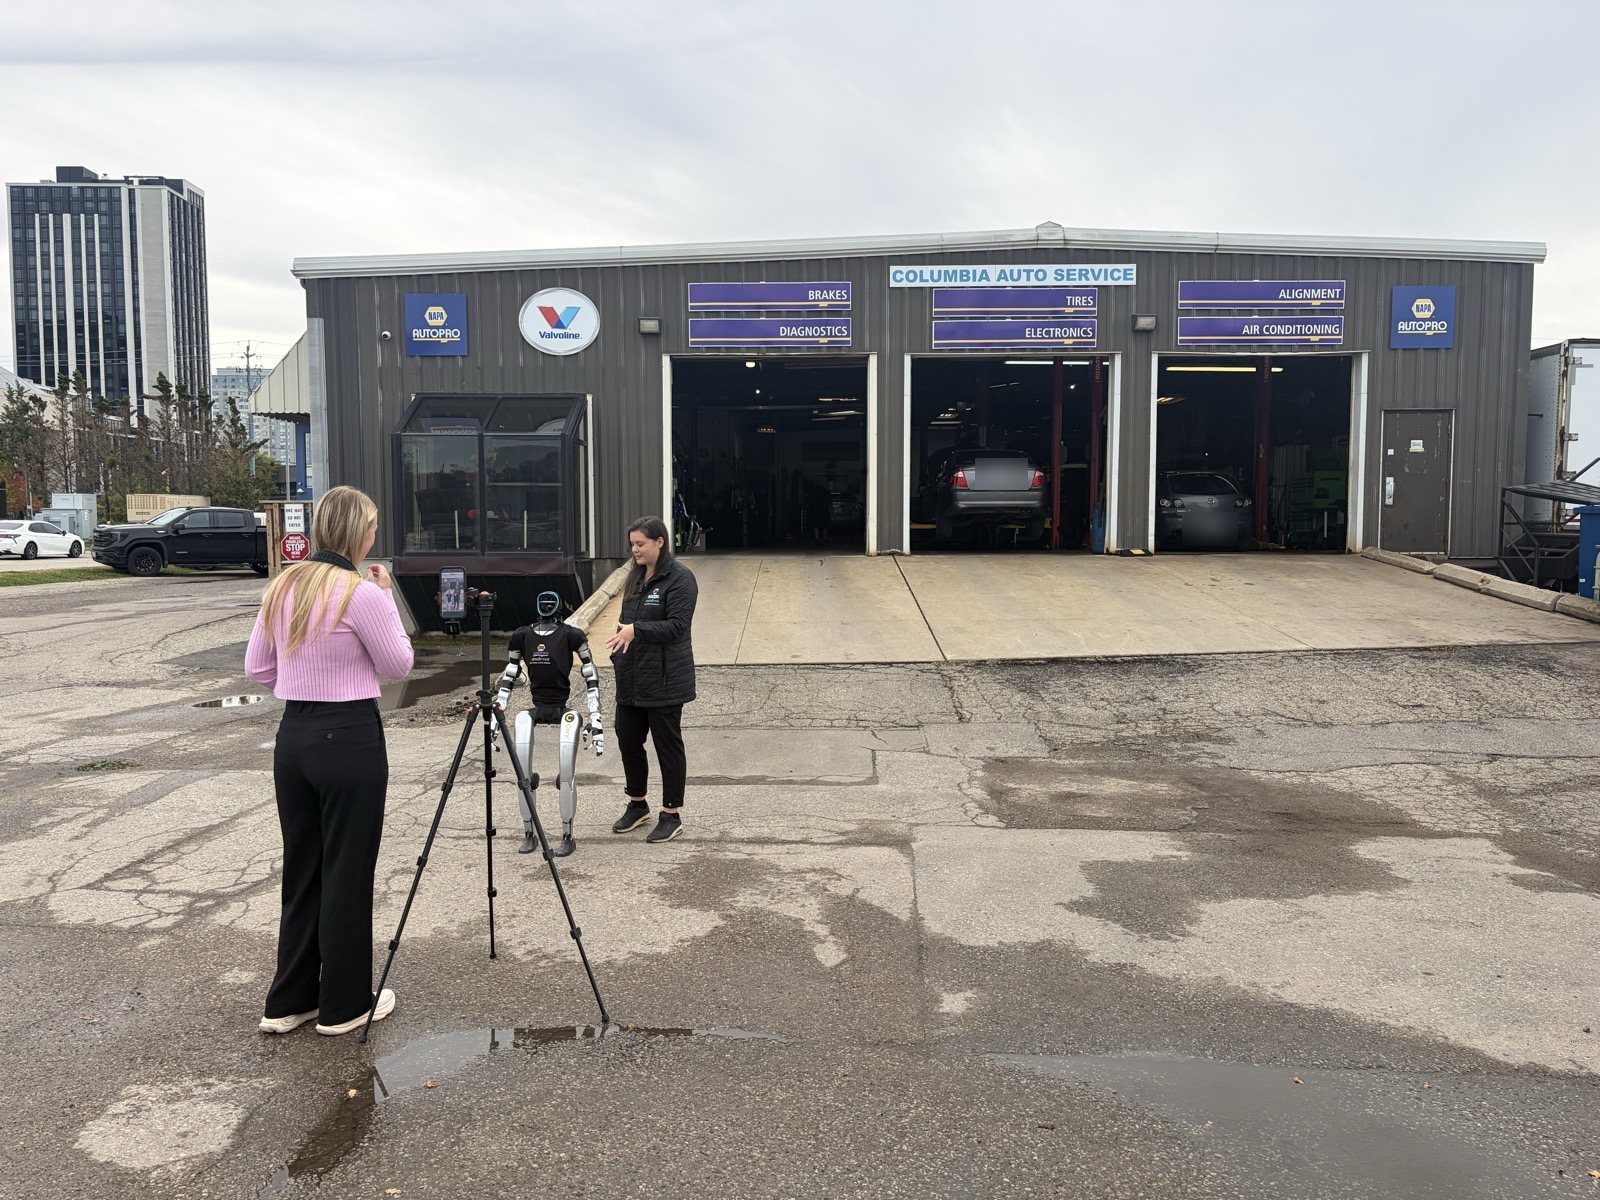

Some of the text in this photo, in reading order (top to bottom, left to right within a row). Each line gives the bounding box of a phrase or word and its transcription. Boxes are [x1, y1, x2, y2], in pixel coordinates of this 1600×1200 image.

[892, 268, 1134, 282] COLUMBIA AUTO SERVICE
[808, 290, 848, 300] BRAKES
[1278, 288, 1341, 300] ALIGNMENT
[1066, 296, 1093, 306] TIRES
[1415, 304, 1431, 314] NAPA
[428, 312, 444, 320] NAPA
[1242, 324, 1340, 336] AIR CONDITIONING
[1398, 320, 1448, 331] AUTOPRO
[412, 328, 460, 338] AUTOPRO
[539, 331, 580, 340] Valvoline
[780, 326, 848, 336] DIAGNOSTICS
[1025, 328, 1093, 338] ELECTRONICS
[286, 544, 306, 552] STOP
